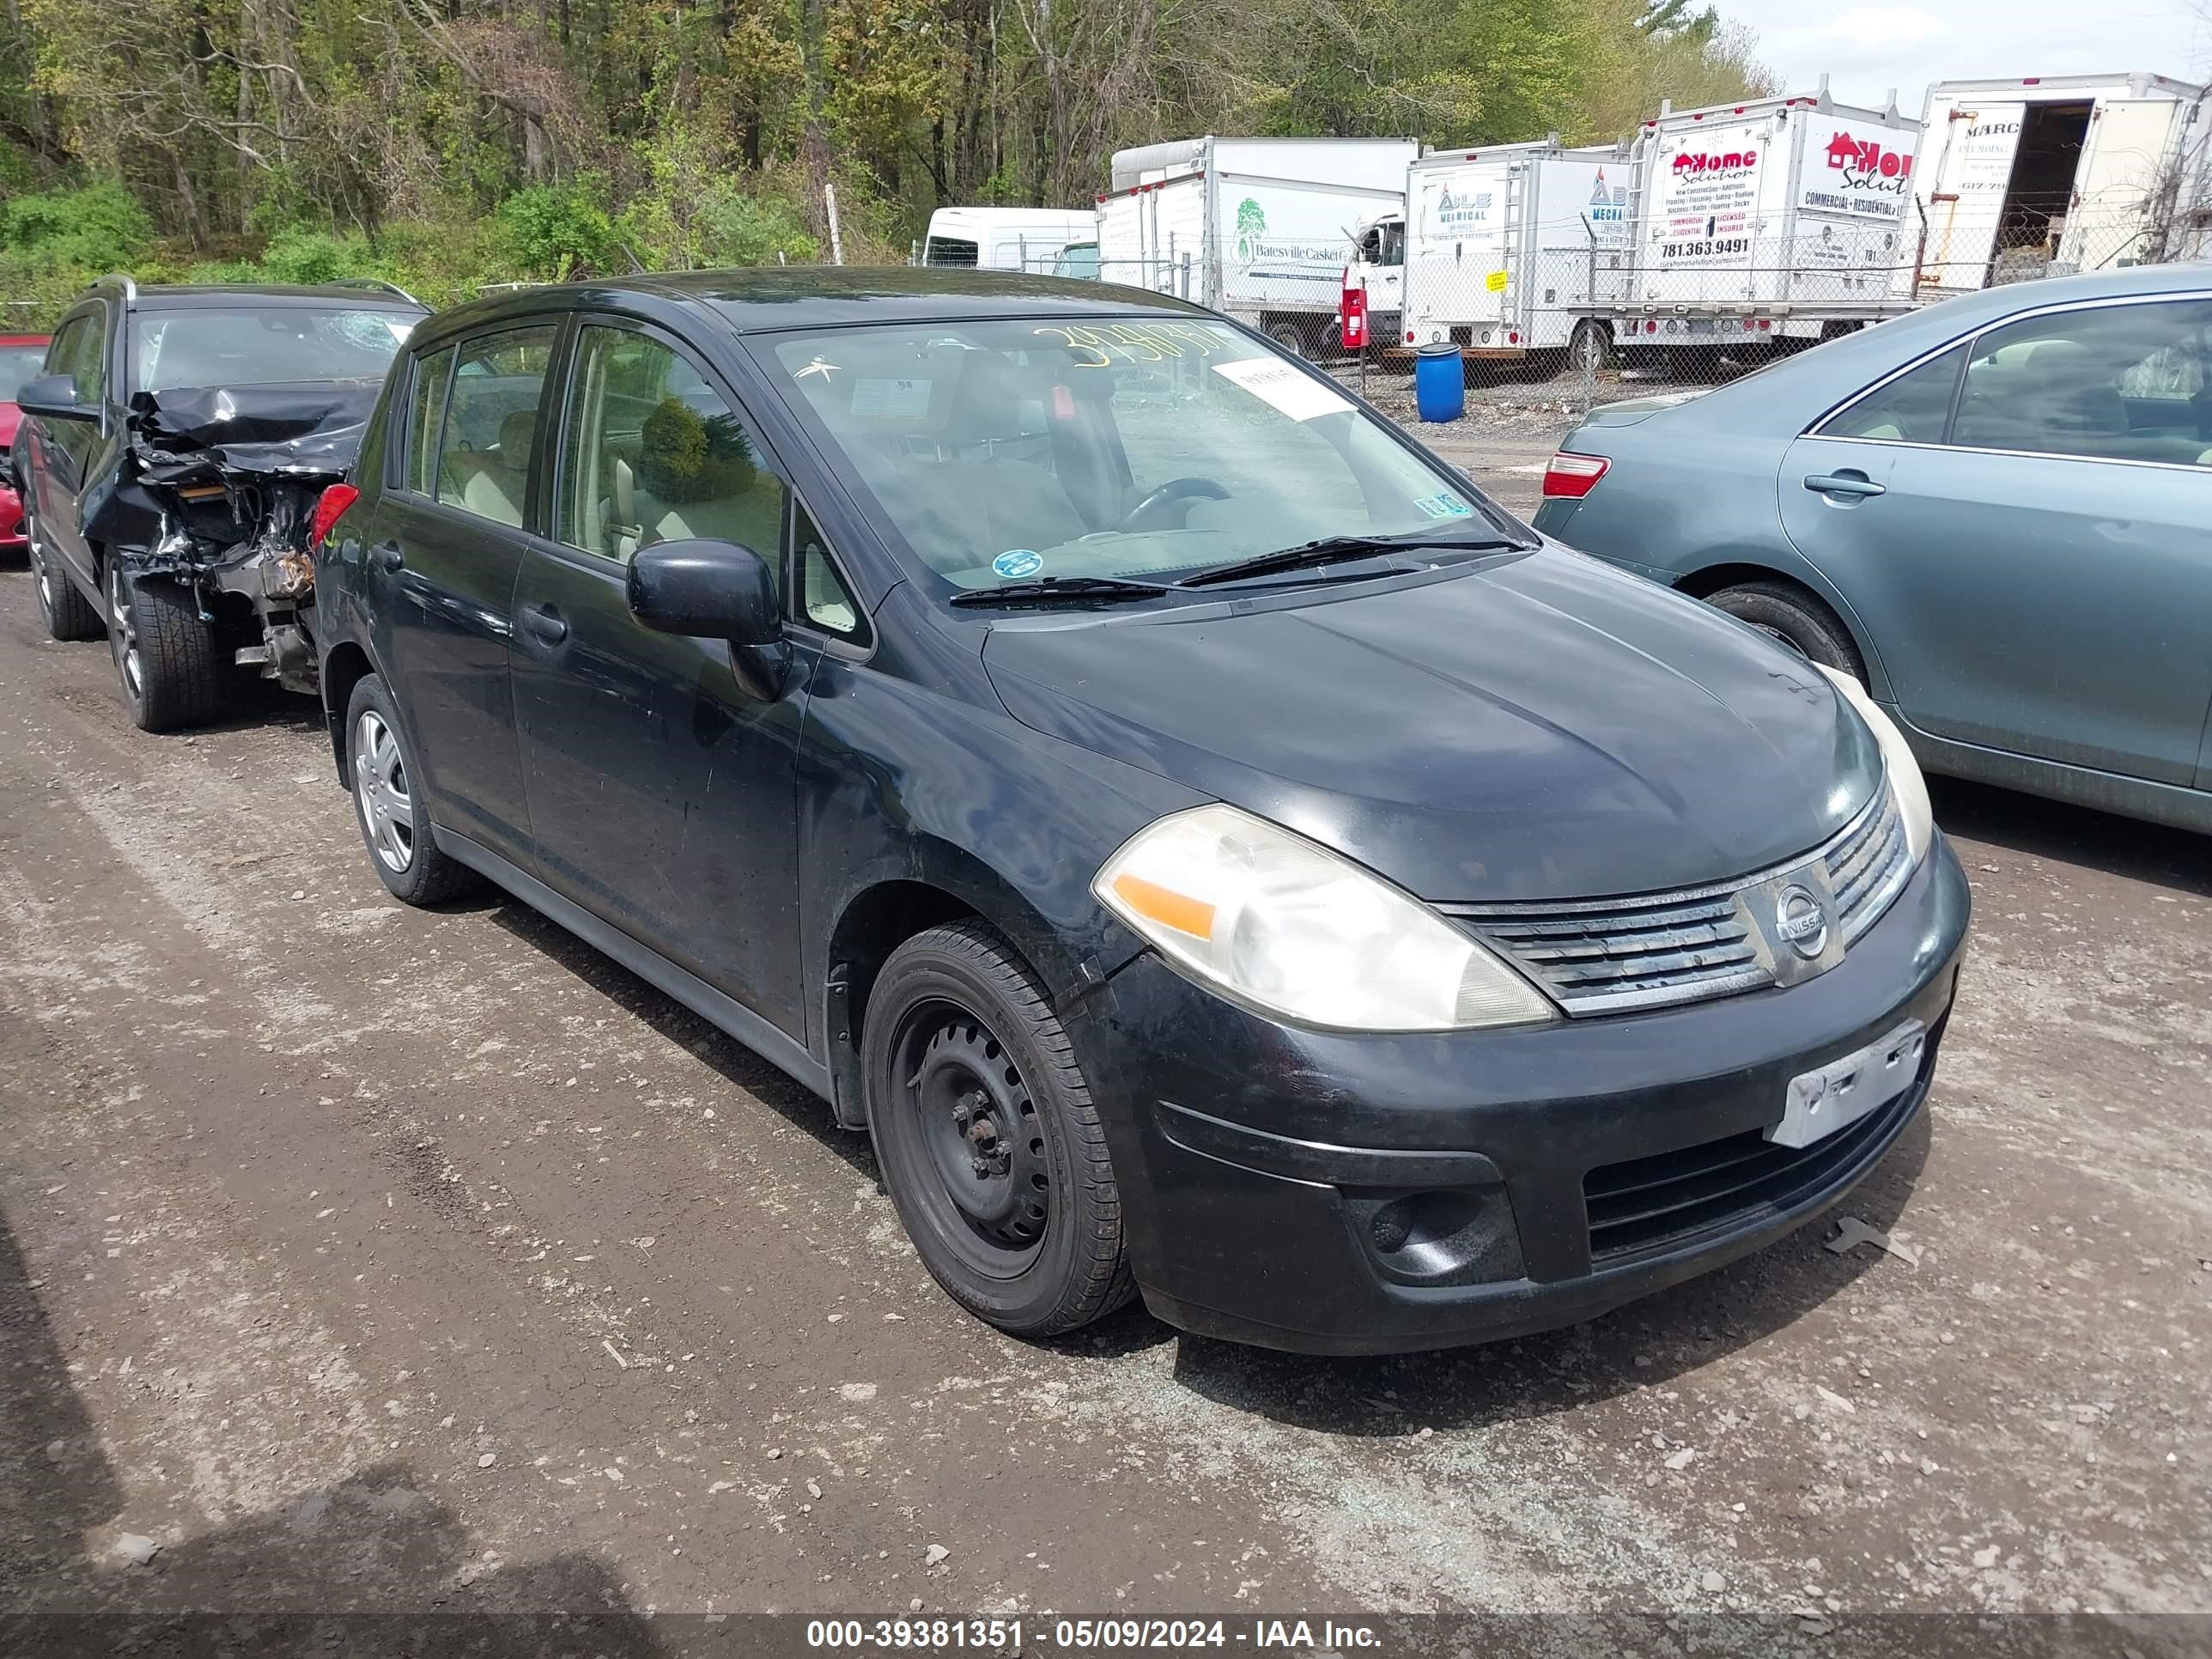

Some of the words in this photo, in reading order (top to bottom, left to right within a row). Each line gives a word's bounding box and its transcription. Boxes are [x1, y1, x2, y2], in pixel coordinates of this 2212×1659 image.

[1681, 167, 1756, 186] Solution
[1689, 195, 1712, 204] Finishing
[1805, 191, 1849, 210] COMMERCIAL
[1853, 198, 1893, 216] RESIDENTIAL
[1717, 213, 1746, 222] LICENSED
[1717, 224, 1744, 233] INSURED
[1256, 244, 1306, 259] Batesville
[1306, 247, 1338, 261] Casket
[1662, 239, 1748, 258] 781.363.9491
